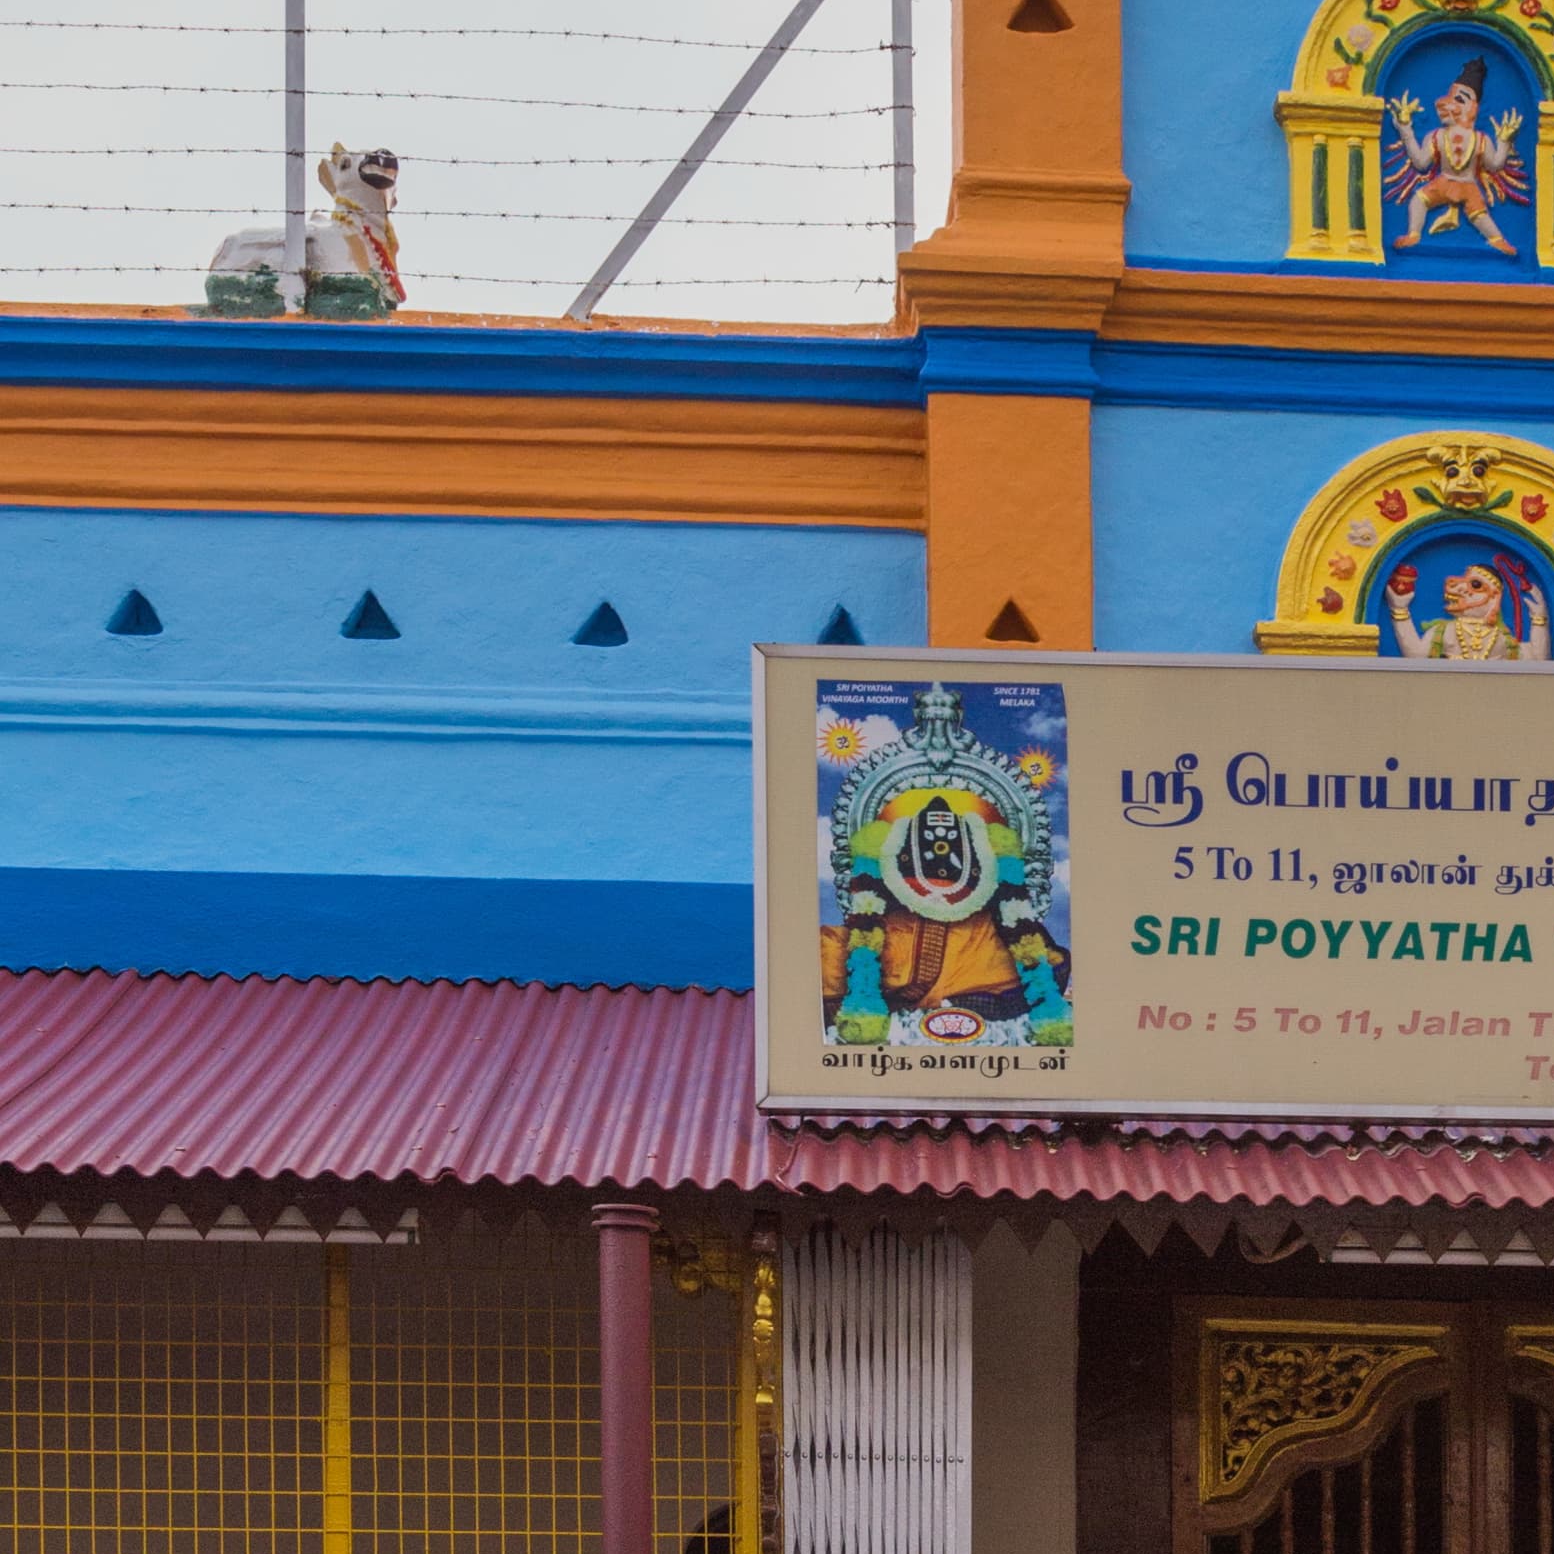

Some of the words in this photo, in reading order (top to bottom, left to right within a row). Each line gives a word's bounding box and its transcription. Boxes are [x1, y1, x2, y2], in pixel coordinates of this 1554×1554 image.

[835, 683, 850, 692] SRI
[851, 683, 894, 693] POIYATHA
[993, 686, 1019, 696] SINCE
[1020, 687, 1041, 696] 1781
[822, 694, 865, 704] VINAYAGA
[866, 695, 909, 705] MOORTHI
[999, 698, 1036, 708] MELAKA
[1174, 846, 1194, 879] 5
[1207, 847, 1252, 881] To
[1269, 848, 1318, 889] 11,
[1333, 854, 1478, 894] ஜாலான்
[1131, 915, 1220, 956] SRI
[1245, 919, 1532, 962] POYYATHA
[1138, 1005, 1192, 1031] No
[1234, 1007, 1256, 1032] 5
[1274, 1008, 1321, 1034] To
[1336, 1010, 1383, 1040] 11,
[1398, 1010, 1511, 1036] Jalan
[822, 1046, 913, 1076] வாழ்க
[920, 1049, 1066, 1078] வளமுடன்
